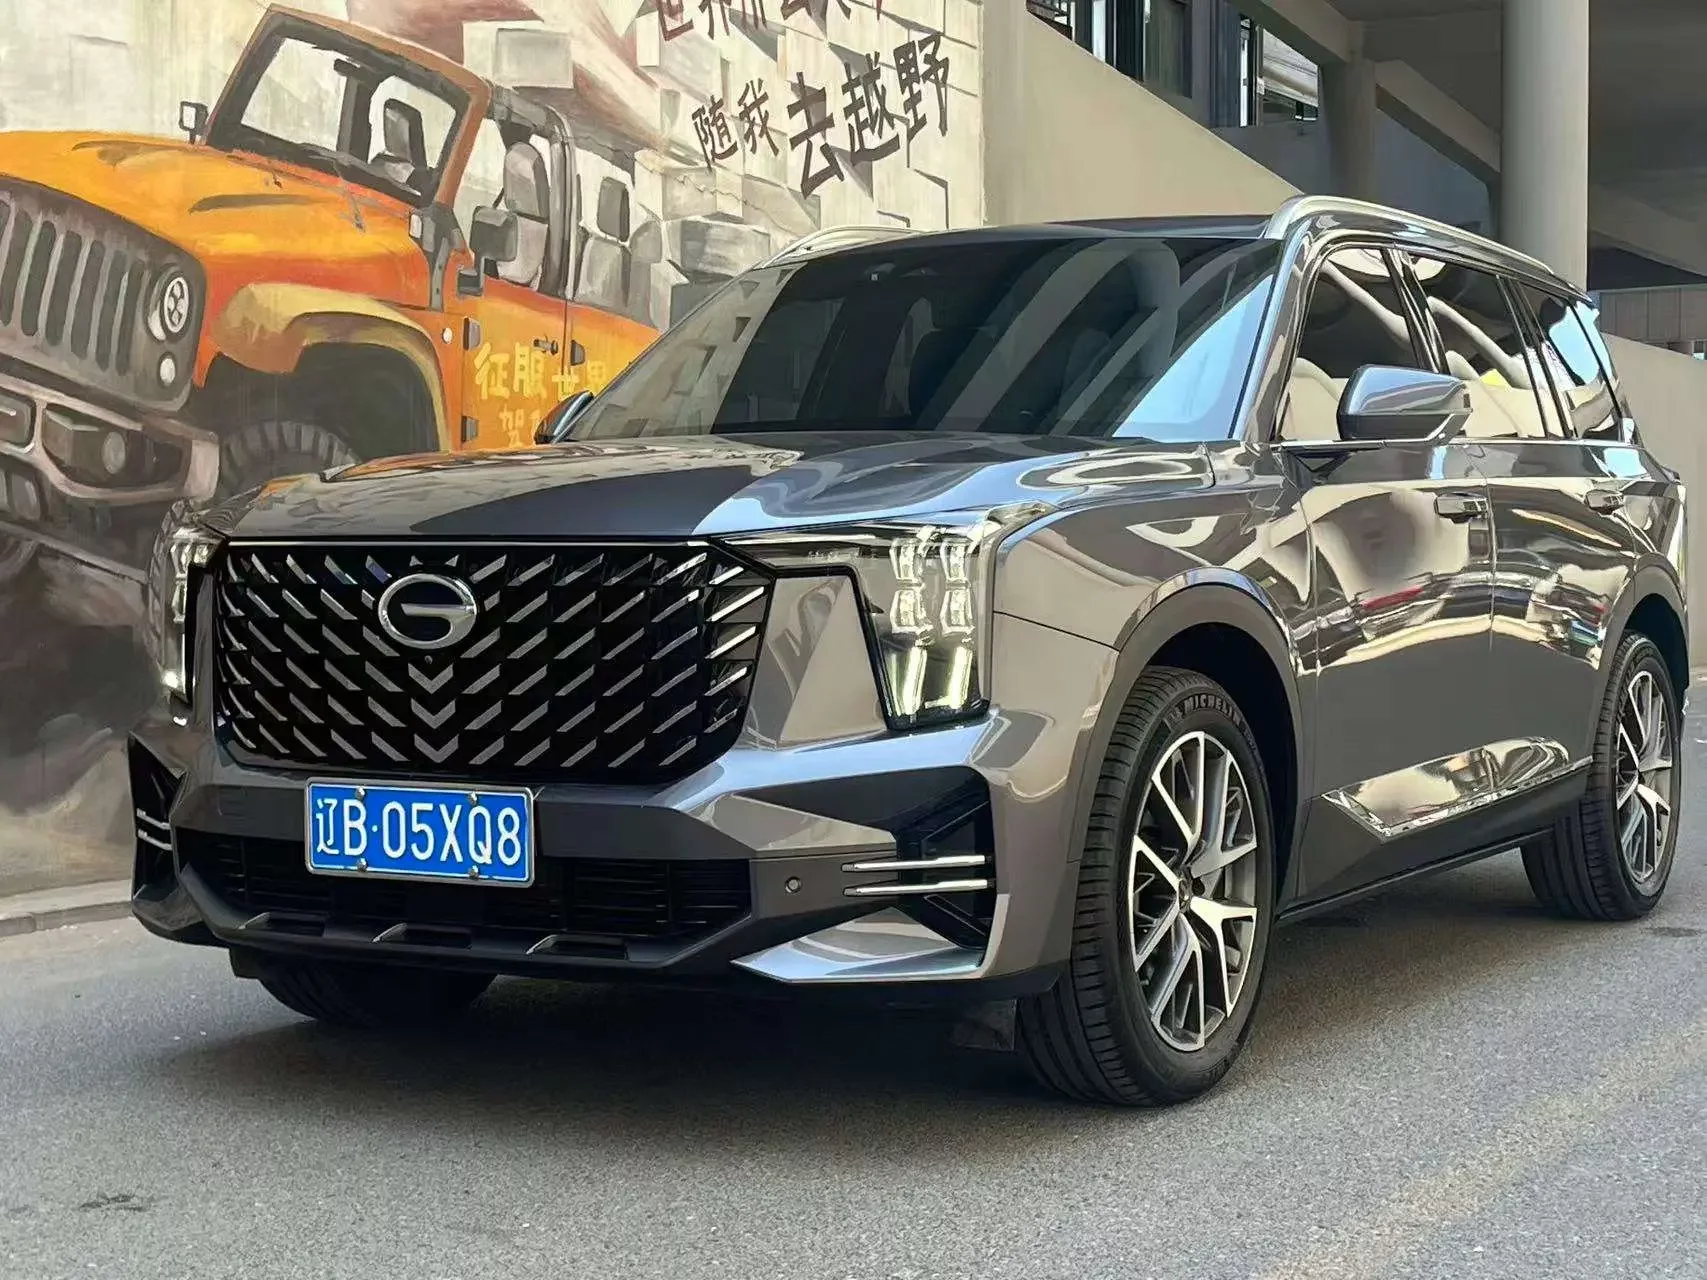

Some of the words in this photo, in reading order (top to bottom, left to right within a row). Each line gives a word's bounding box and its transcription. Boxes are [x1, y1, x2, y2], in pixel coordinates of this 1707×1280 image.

[692, 32, 950, 200] 随我去越野
[1184, 694, 1241, 726] MICHELIN
[316, 798, 521, 866] 辽B·05XQ8
